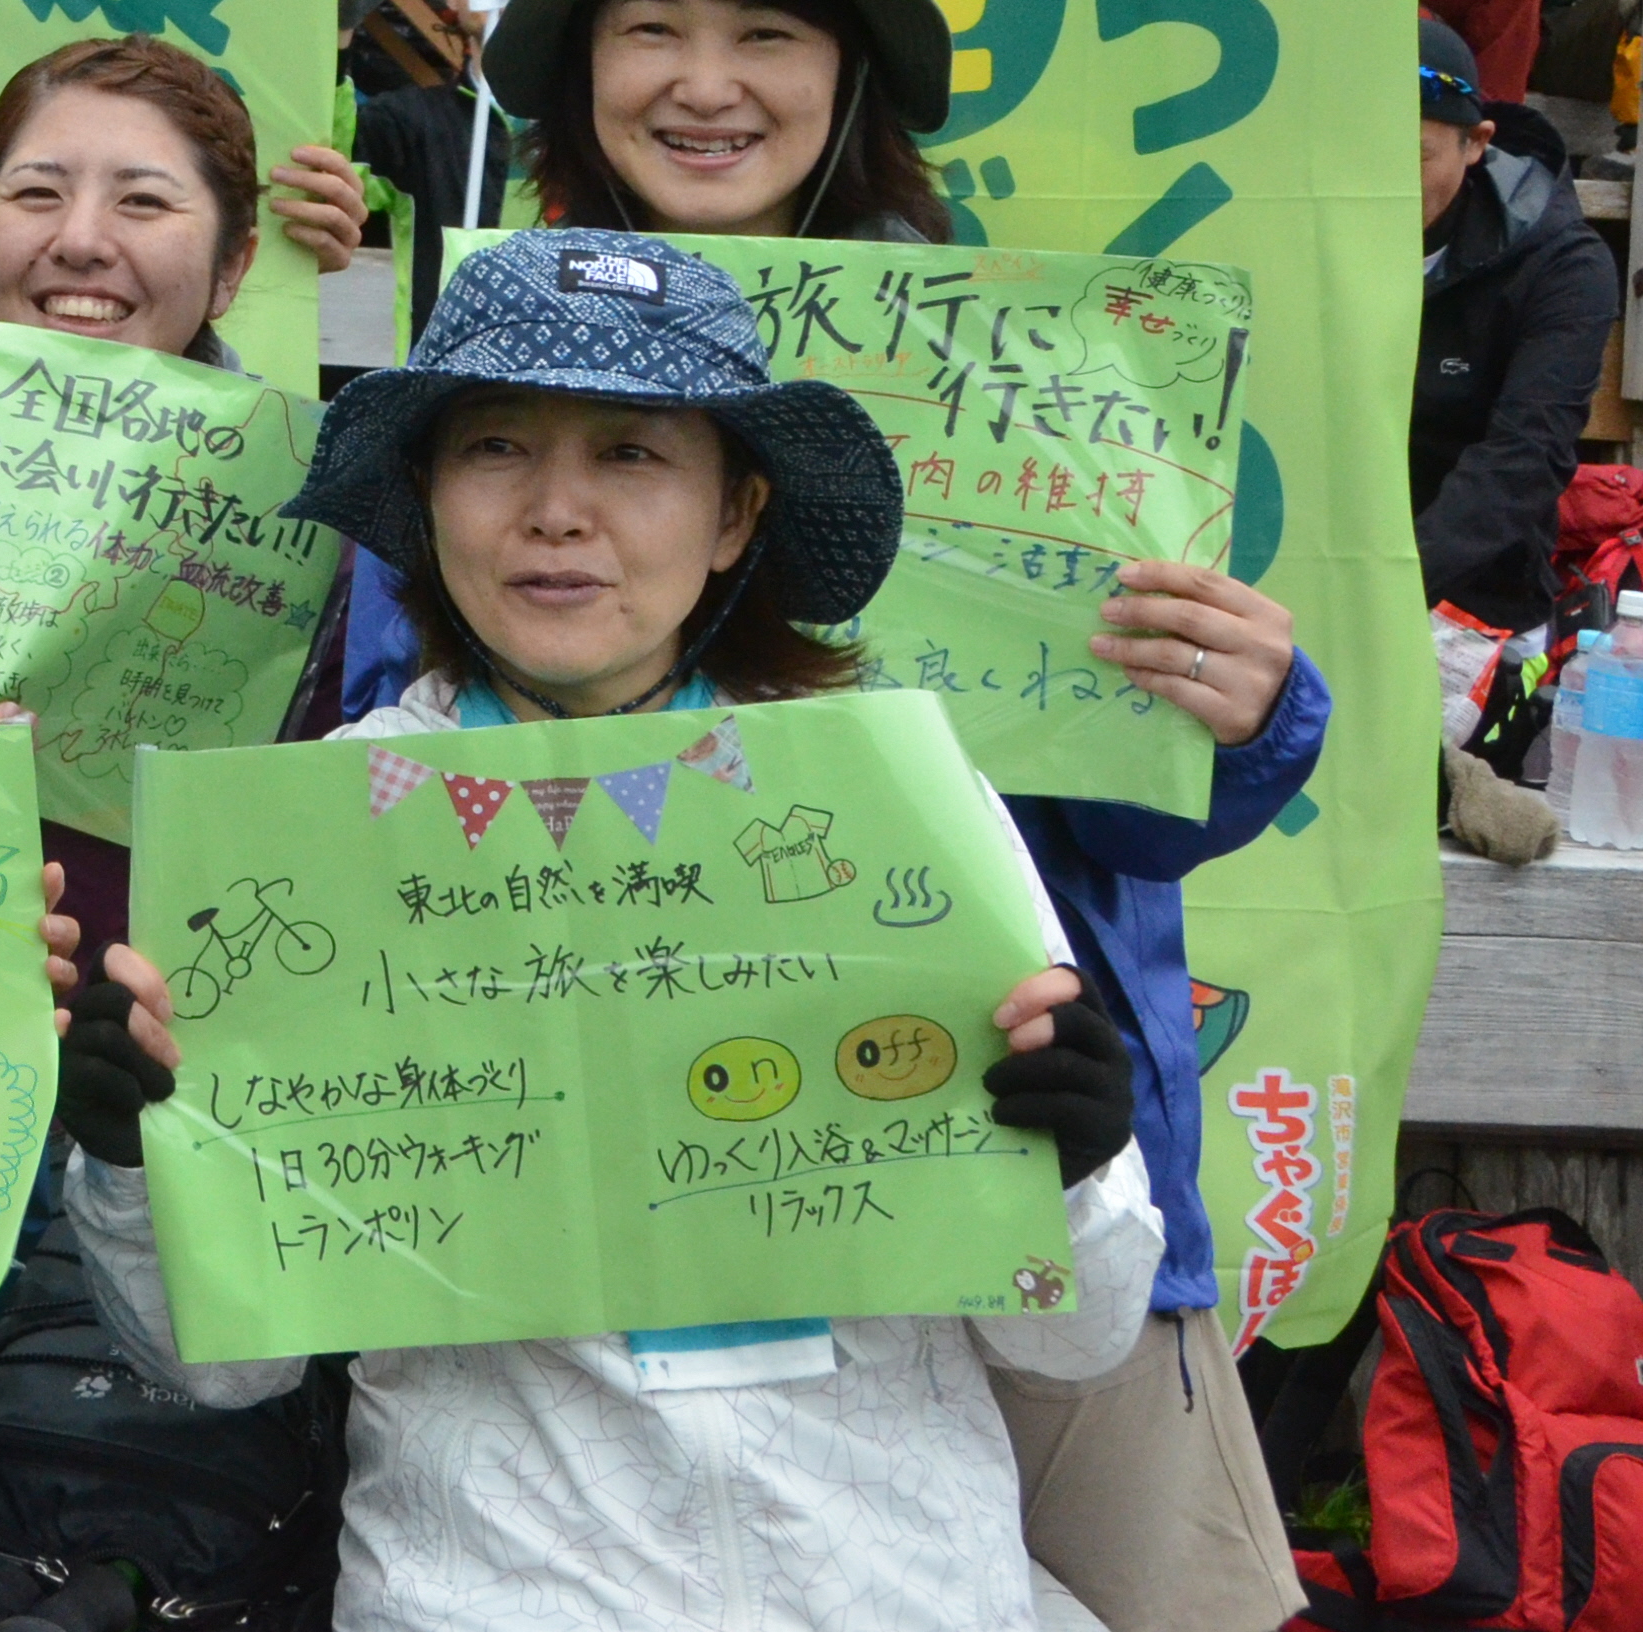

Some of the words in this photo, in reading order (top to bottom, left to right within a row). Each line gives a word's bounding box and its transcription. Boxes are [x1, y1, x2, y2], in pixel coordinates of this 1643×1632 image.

[569, 259, 629, 278] NORTH
[585, 269, 628, 285] FACE
[596, 254, 629, 266] THE
[397, 859, 716, 925] 東北の自然を満喫
[362, 935, 839, 1015] 小さな旅を楽しみたい
[211, 1055, 527, 1129] しなやかな身体づくり
[272, 1204, 464, 1271] トランポリン
[749, 1180, 895, 1237] リラックス
